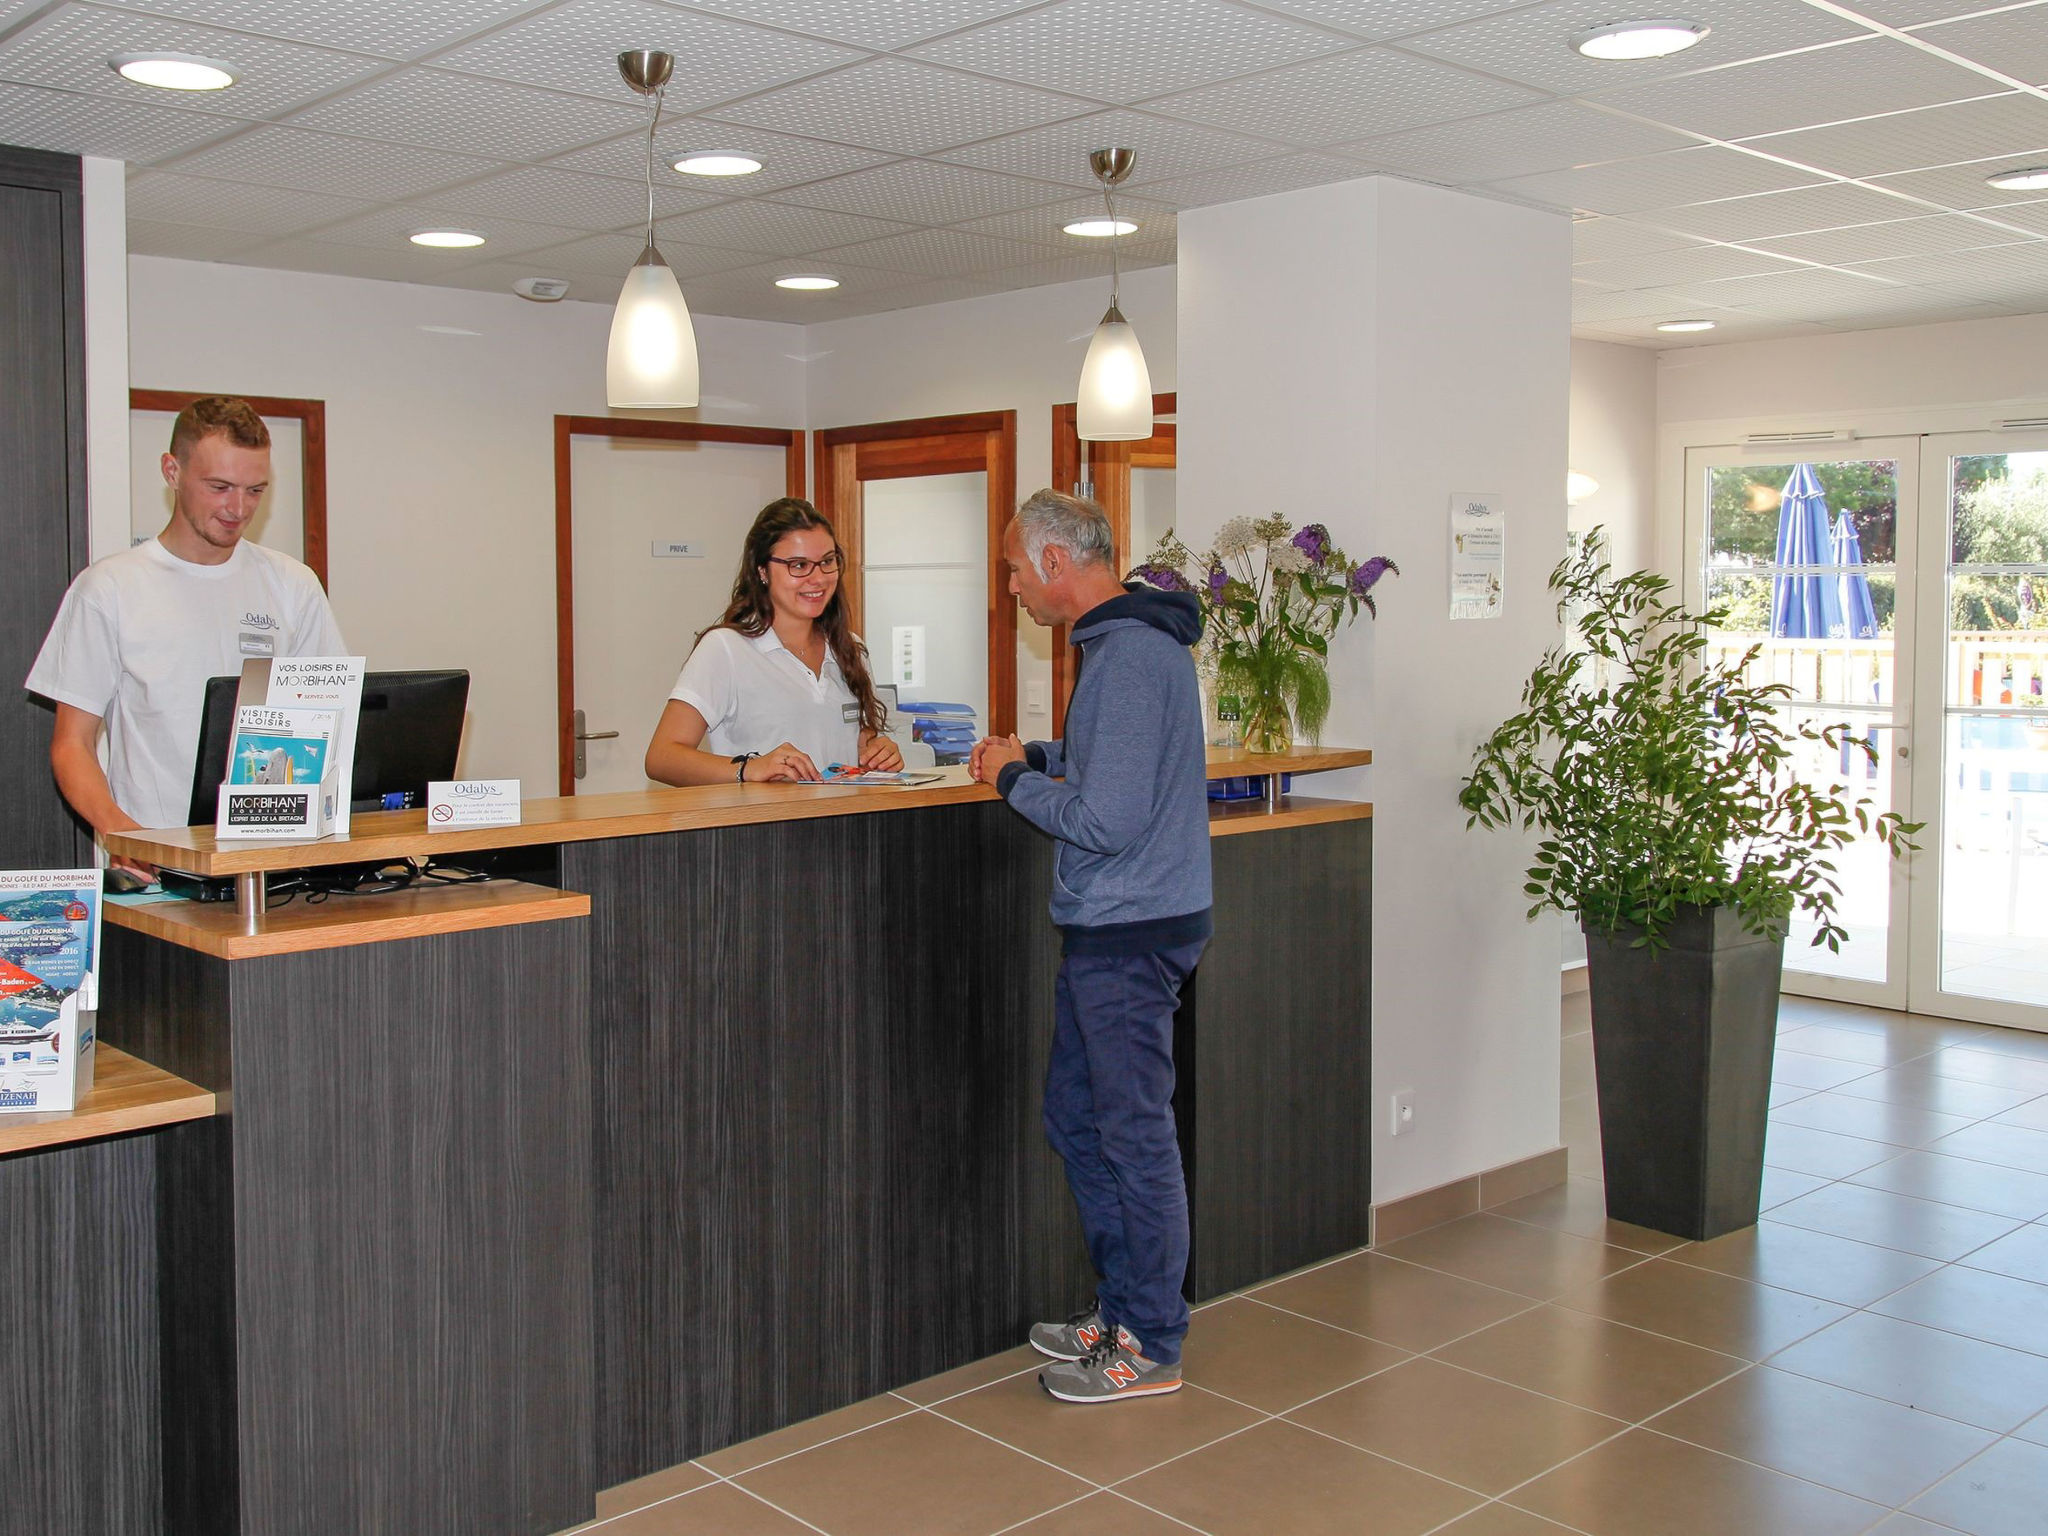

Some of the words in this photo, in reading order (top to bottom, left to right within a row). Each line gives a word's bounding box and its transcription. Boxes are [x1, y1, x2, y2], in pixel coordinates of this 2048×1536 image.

[276, 676, 346, 686] MORBIHAN
[242, 709, 284, 718] VISITES
[248, 718, 291, 727] LOISIRS
[453, 783, 498, 796] Odalys
[232, 797, 296, 808] MORBIHAN
[1076, 1325, 1100, 1350] N
[1103, 1360, 1139, 1388] N
